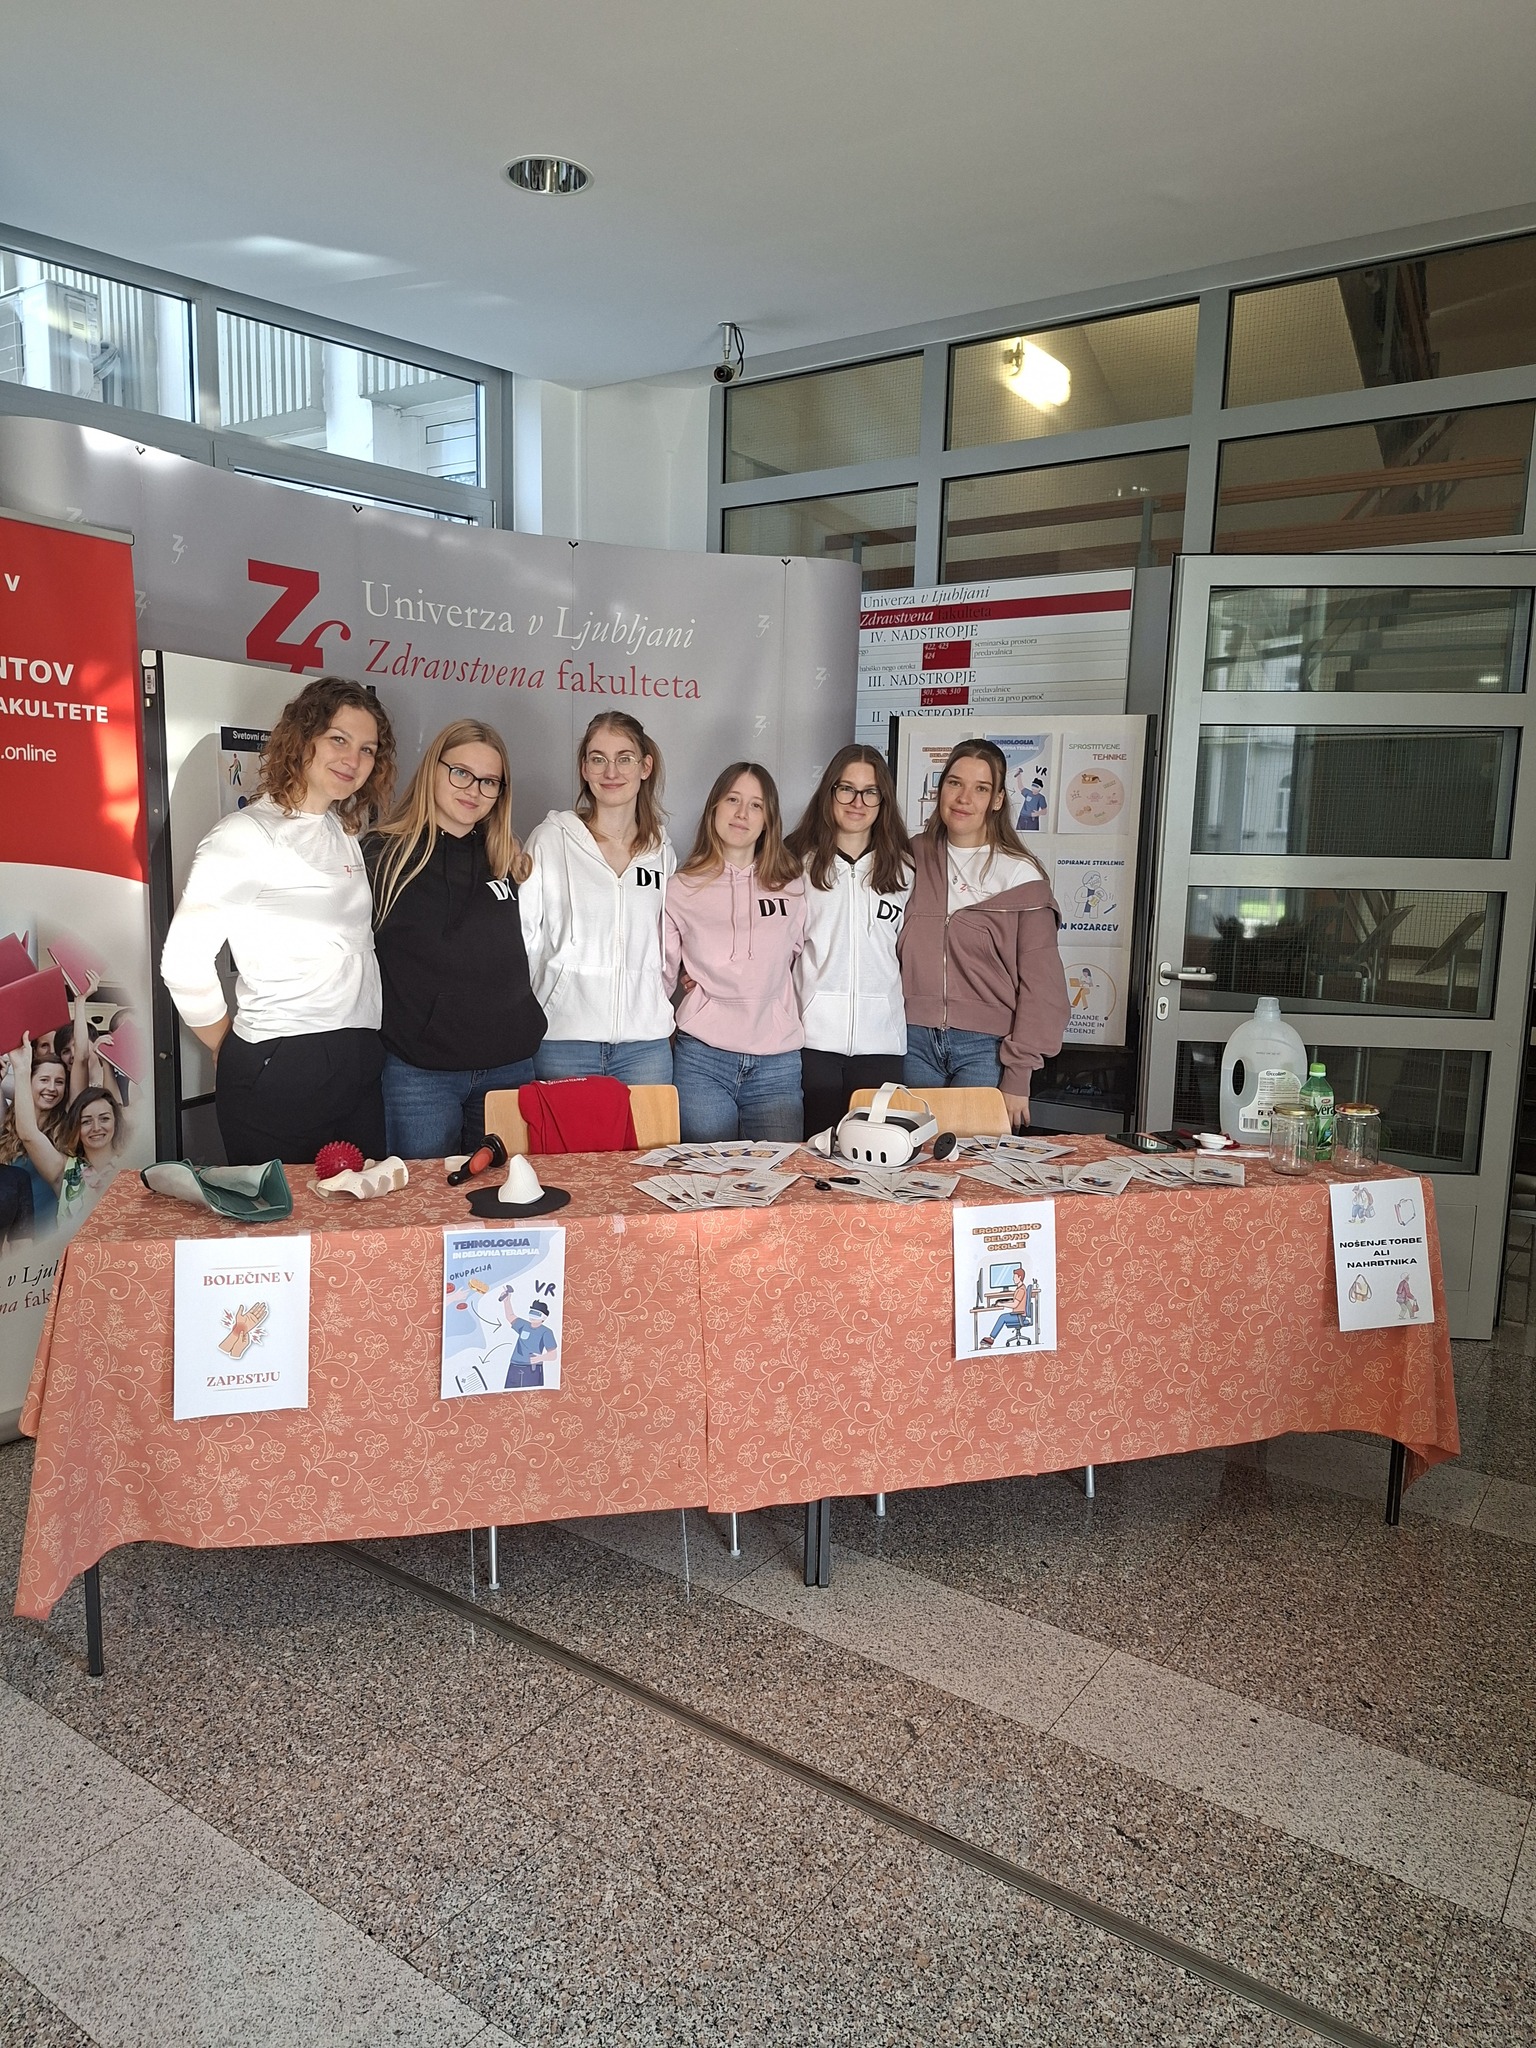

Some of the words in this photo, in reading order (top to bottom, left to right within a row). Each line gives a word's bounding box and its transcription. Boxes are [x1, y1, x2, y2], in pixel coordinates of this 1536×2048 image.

[864, 596, 915, 608] Univerza
[921, 594, 928, 603] v
[932, 586, 990, 605] Ljubljani
[362, 580, 514, 634] Univerza
[528, 614, 544, 637] v
[553, 606, 696, 656] Ljubljani
[860, 611, 934, 626] Zdravstvena
[938, 606, 991, 620] fakulteta
[871, 631, 886, 643] IV.
[891, 624, 978, 642] NADSTROPJE
[366, 638, 545, 690] Zdravstvena
[557, 658, 701, 699] fakulteta
[868, 675, 885, 687] III.
[890, 671, 977, 686] NADSTROPJE
[872, 711, 884, 722] II.
[233, 730, 260, 741] Svetovni
[1092, 753, 1127, 761] TEHNIKE
[1035, 766, 1047, 776] VR
[636, 866, 664, 891] DT
[757, 898, 790, 917] DT
[876, 899, 903, 923] DT
[1070, 922, 1119, 932] KOZARCEV
[1071, 1013, 1099, 1021] EDANJE
[972, 1223, 1042, 1235] ERGONOMSKO
[453, 1238, 530, 1250] TEHNOLOGIJA
[984, 1233, 1029, 1243] DELOVNO
[1339, 1239, 1387, 1248] NOŠENJE
[1389, 1237, 1422, 1245] TORBE
[987, 1242, 1026, 1251] OKOLJE
[452, 1251, 461, 1260] IN
[462, 1249, 500, 1259] DELOVNA
[500, 1247, 540, 1256] TERAPIJA
[1347, 1258, 1417, 1269] NAHRBTNIKA
[203, 1271, 280, 1286] BOLEČINE
[284, 1271, 294, 1282] V
[450, 1263, 492, 1281] OKUPACIJA
[8, 1275, 16, 1287] v
[535, 1280, 556, 1297] VR
[207, 1371, 280, 1387] ZAPESTJU
